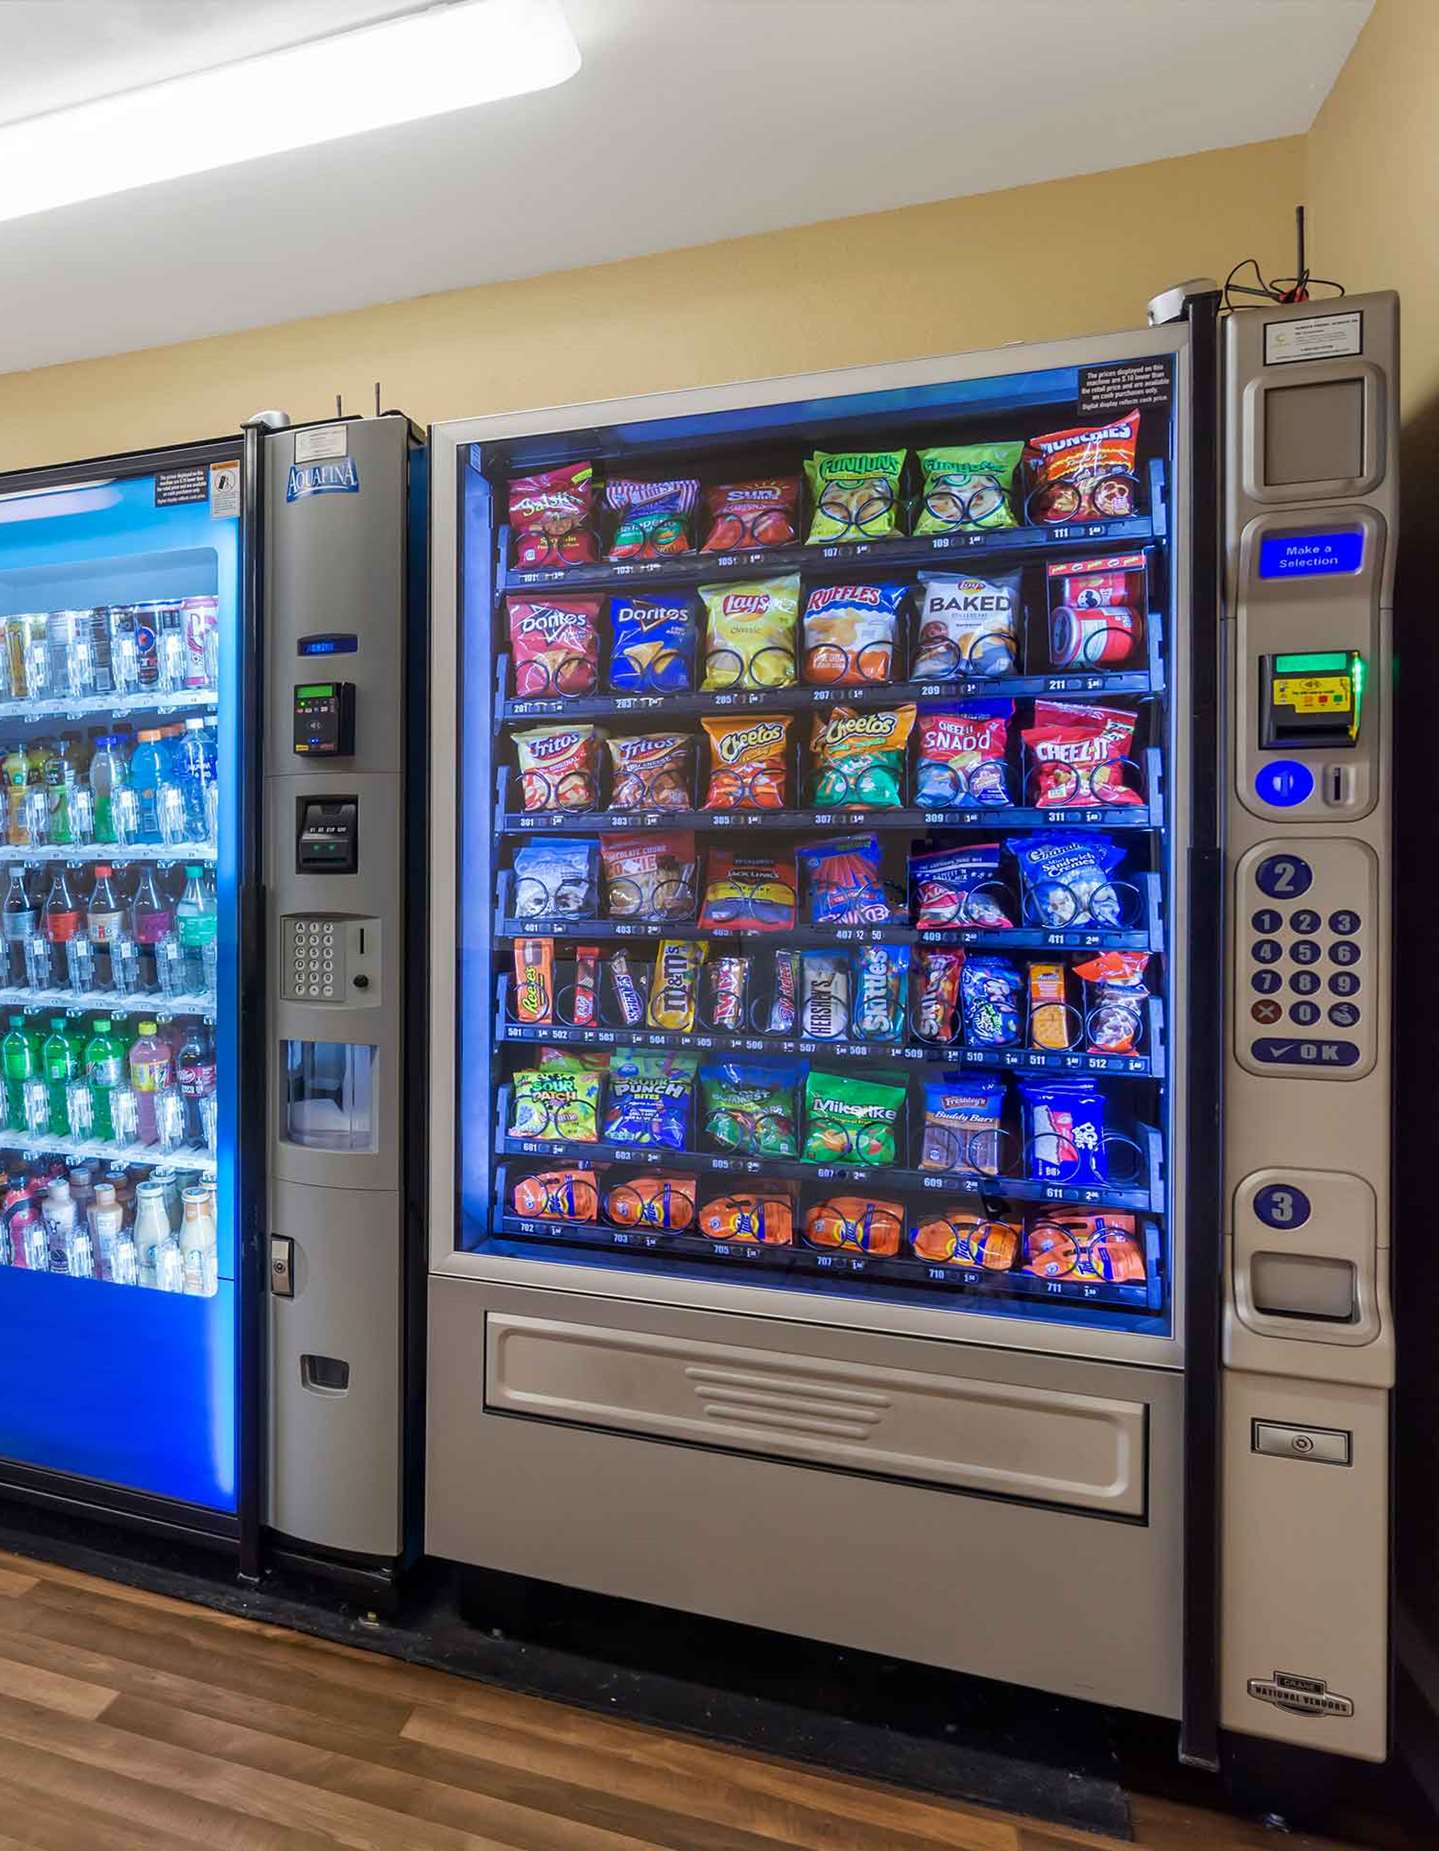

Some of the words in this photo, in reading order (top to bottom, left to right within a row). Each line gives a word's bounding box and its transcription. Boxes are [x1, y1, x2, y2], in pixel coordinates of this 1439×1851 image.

[288, 459, 356, 496] AQUAFINA
[1054, 528, 1068, 538] 111
[932, 538, 949, 548] 109
[823, 548, 838, 557] 107
[1286, 546, 1320, 556] Make
[1324, 545, 1332, 553] a
[1280, 556, 1338, 568] Selection
[809, 585, 881, 610] RUFFLES
[929, 596, 1012, 613] BAKED
[619, 607, 688, 622] Doritos
[1049, 680, 1066, 690] 211
[814, 690, 829, 700] 207
[921, 686, 940, 696] 209
[826, 713, 894, 744] Cheetos
[528, 730, 580, 757] Fritos
[720, 722, 784, 763] Cheetos
[620, 738, 677, 760] Fritos
[815, 815, 832, 824] 307
[925, 814, 944, 823] 309
[1049, 812, 1065, 822] 311
[1274, 862, 1295, 892] 2
[1262, 914, 1270, 929] 1
[1298, 914, 1311, 930] 2
[1338, 915, 1351, 930] 3
[616, 925, 632, 934] 403
[836, 930, 852, 940] 407
[872, 930, 882, 940] 50
[923, 932, 942, 942] 409
[1048, 934, 1064, 944] 411
[1260, 944, 1272, 960] 4
[1298, 945, 1311, 960] 5
[1338, 946, 1351, 962] 6
[1262, 974, 1272, 989] 7
[1298, 974, 1310, 990] 8
[1338, 976, 1350, 992] 9
[1298, 1005, 1310, 1020] 0
[508, 1028, 522, 1036] 501
[552, 1030, 567, 1040] 502
[599, 1033, 614, 1042] 503
[800, 1044, 816, 1052] 507
[904, 1048, 923, 1058] 509
[1300, 1044, 1339, 1060] OK
[967, 1052, 984, 1062] 510
[1030, 1056, 1046, 1065] 511
[1090, 1058, 1106, 1068] 512
[530, 1080, 574, 1092] SOUR
[614, 1083, 685, 1099] PUNCH
[934, 1110, 969, 1123] Buddy
[971, 1113, 994, 1123] Bars
[924, 1178, 943, 1188] 609
[1046, 1188, 1063, 1198] 611
[1271, 1192, 1293, 1222] 3
[520, 1222, 534, 1232] 702
[817, 1256, 832, 1266] 707
[929, 1269, 944, 1280] 710
[1047, 1282, 1062, 1293] 711
[1255, 1686, 1300, 1702] NATIONAL
